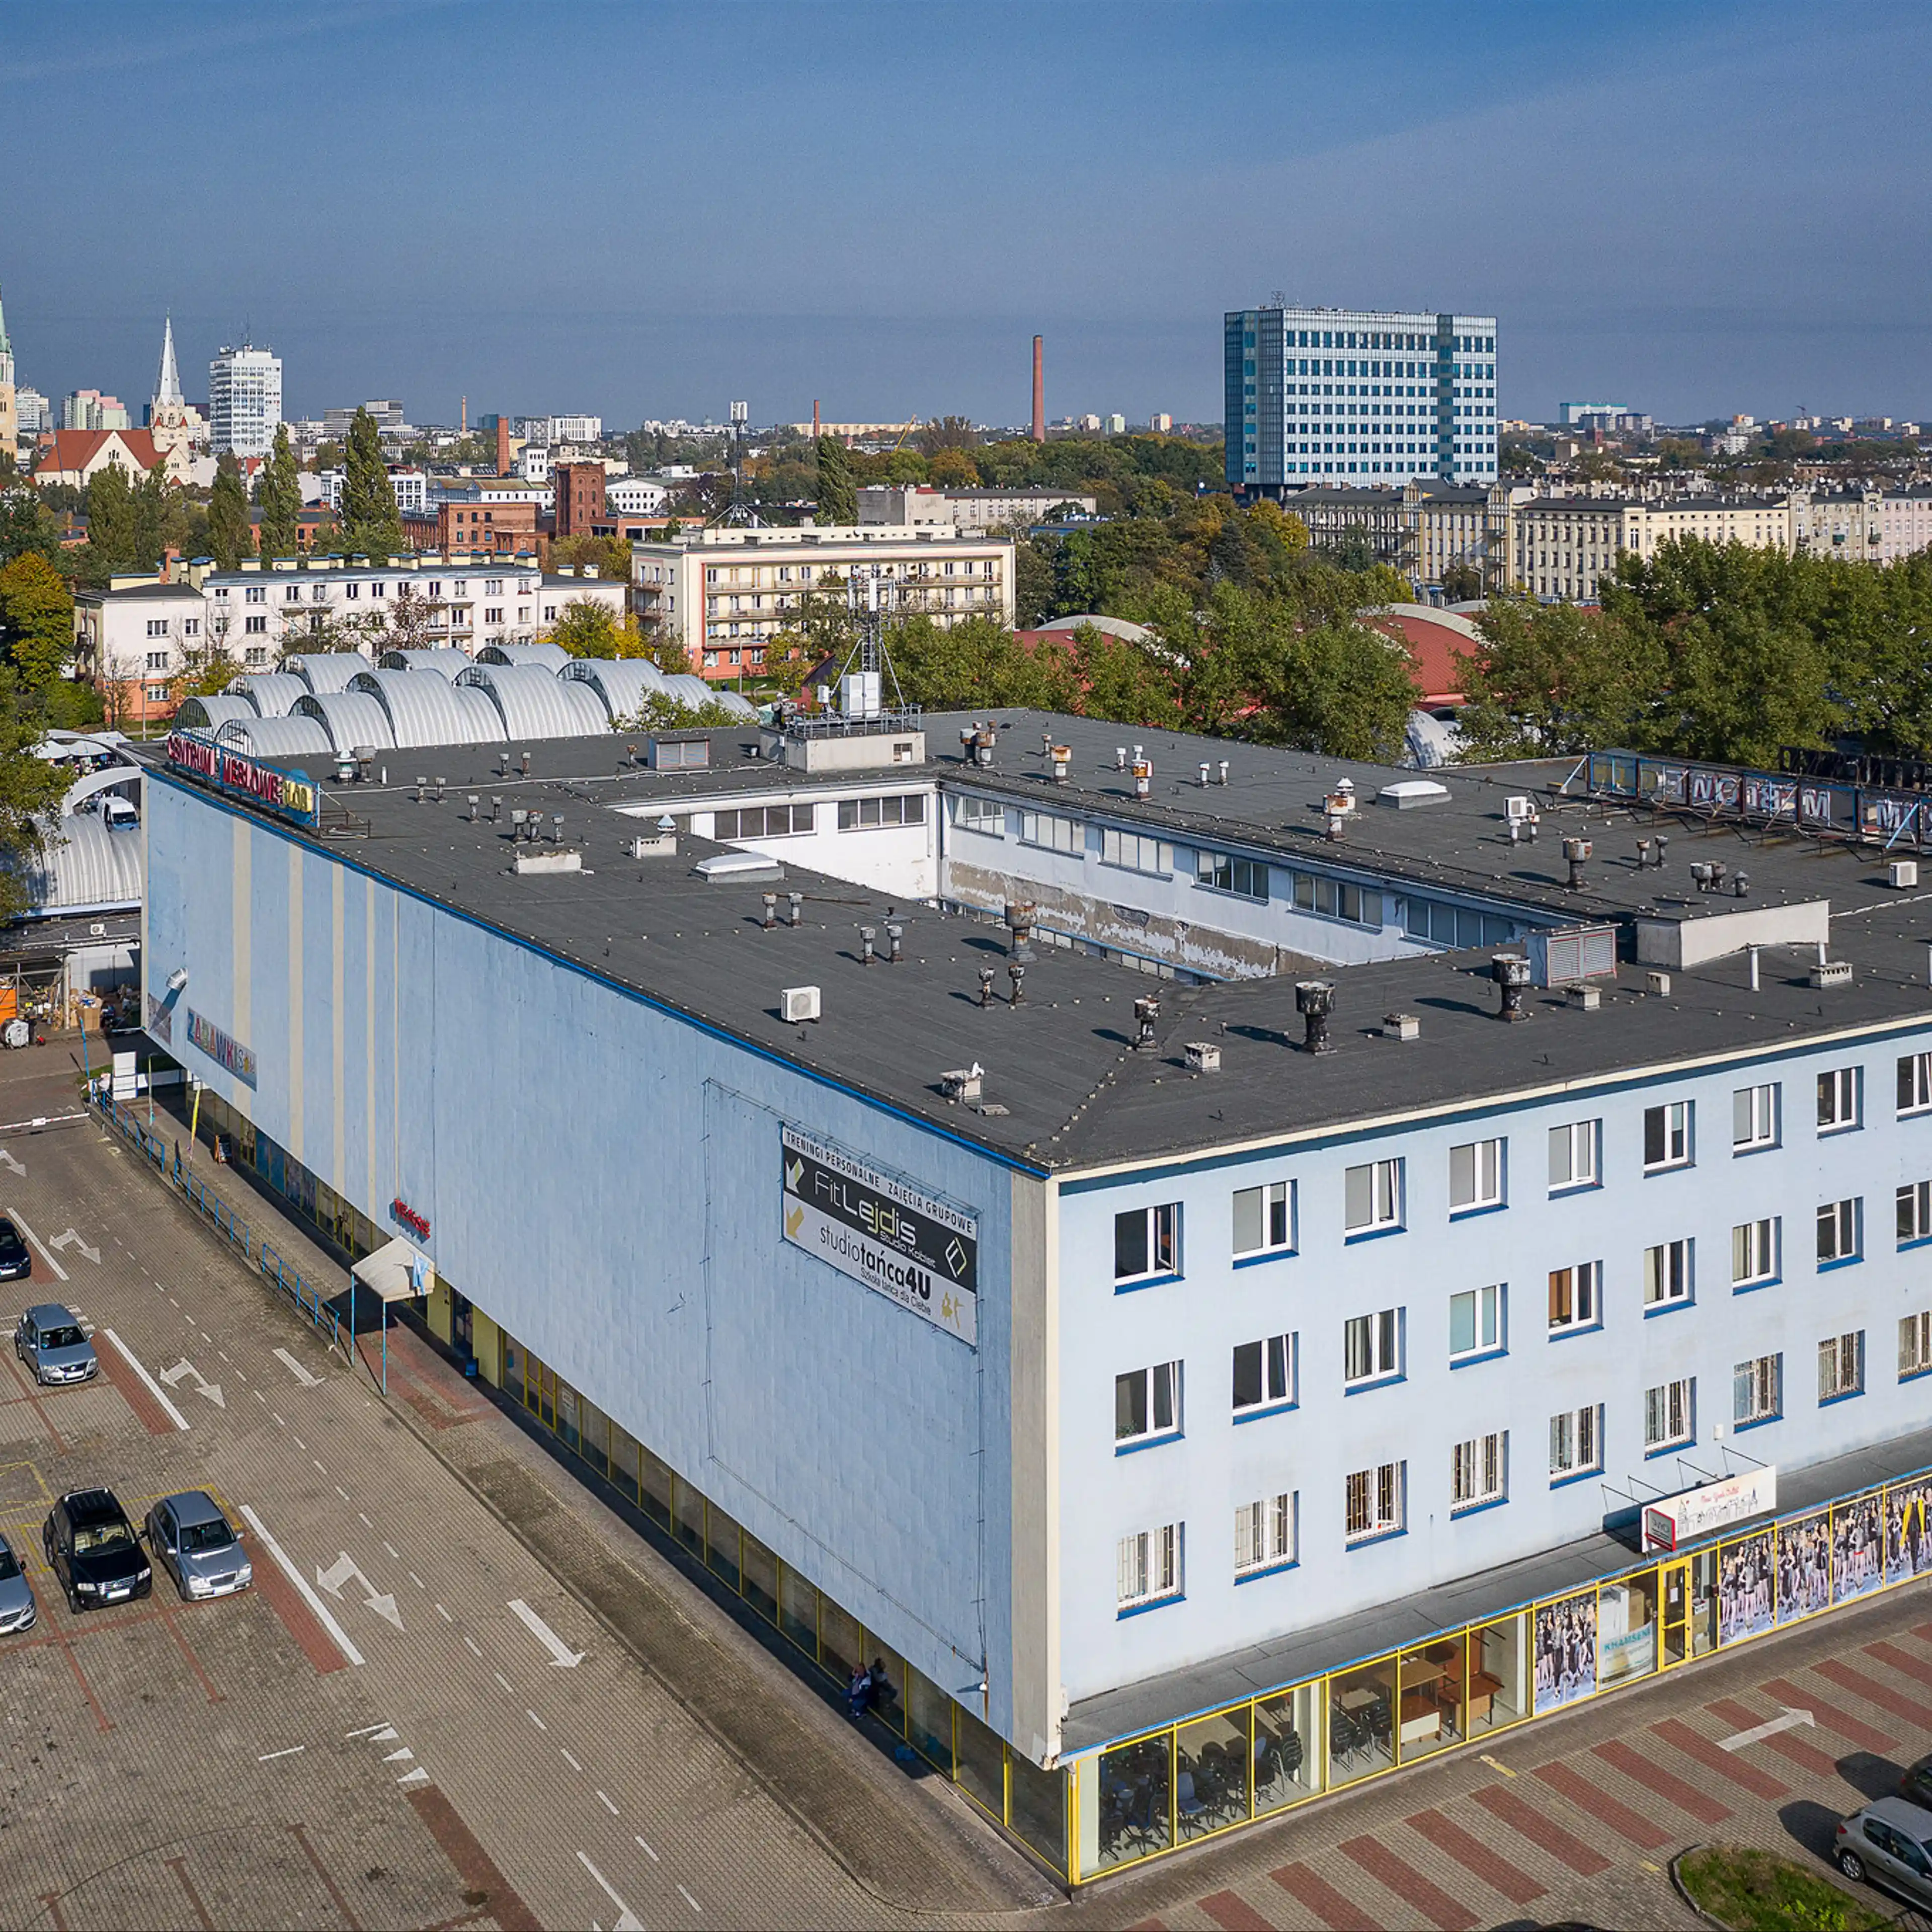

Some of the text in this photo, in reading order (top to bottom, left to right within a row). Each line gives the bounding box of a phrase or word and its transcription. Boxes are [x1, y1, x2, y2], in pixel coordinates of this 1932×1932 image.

[187, 1010, 237, 1072] ZABAWKI
[786, 1131, 973, 1234] TRENINGI PERSONALNE ZAJĘCIA GRUPOWE
[814, 1170, 916, 1246] FitLejdis
